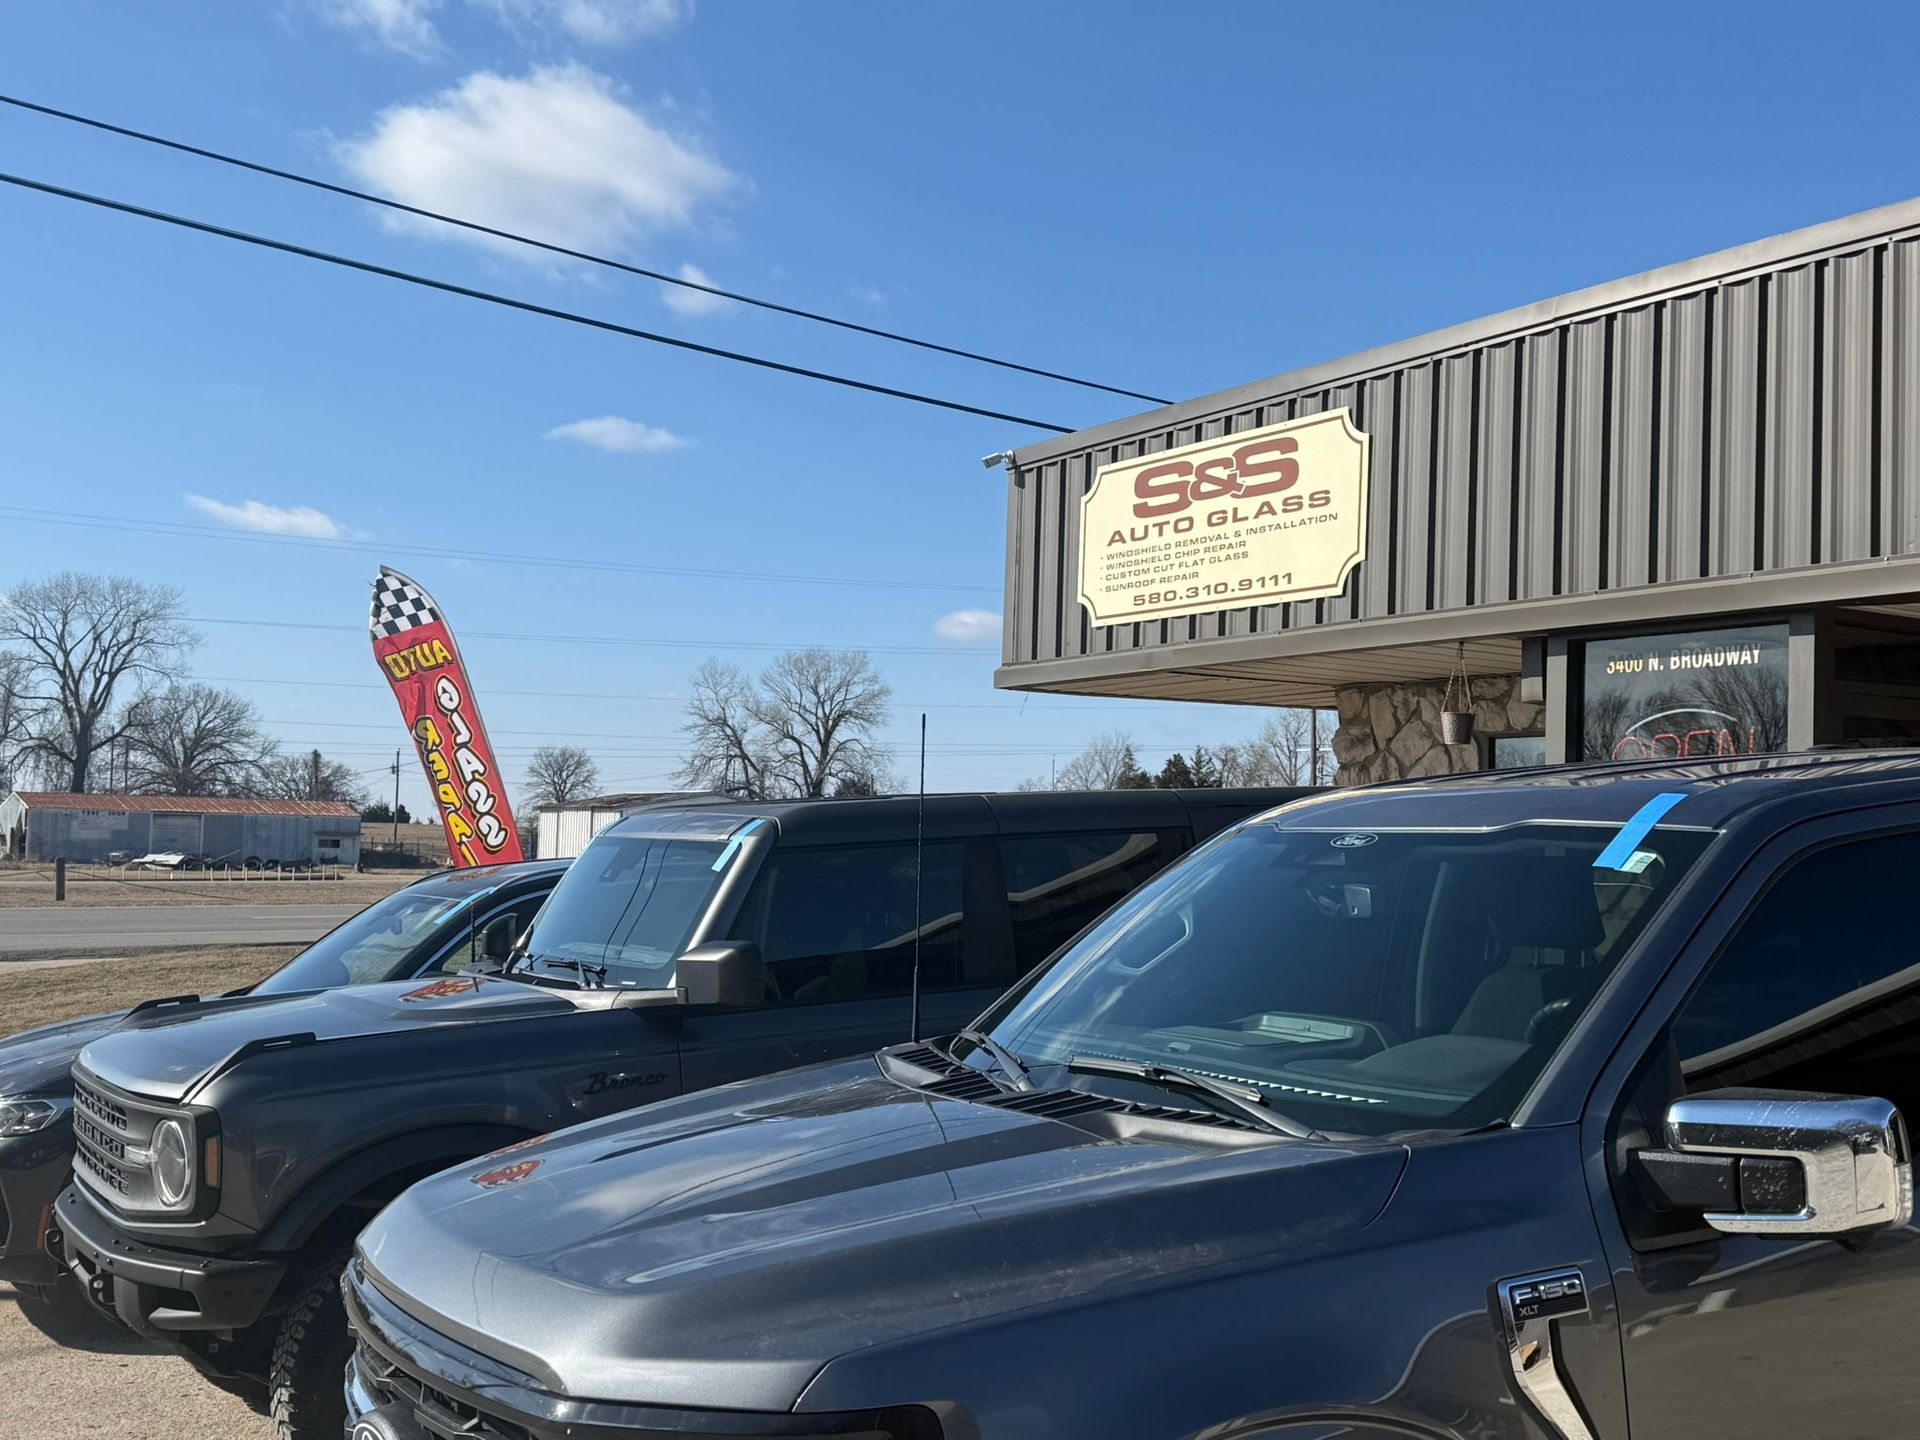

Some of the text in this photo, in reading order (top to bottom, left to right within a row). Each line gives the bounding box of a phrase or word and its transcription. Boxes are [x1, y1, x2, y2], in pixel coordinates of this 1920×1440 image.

[1133, 437, 1299, 519] S&S
[1106, 489, 1331, 547] AUTO GLASS
[1106, 513, 1338, 560] WINDSHIELD REMOVAL & INSTALLATION
[1105, 551, 1249, 581] CUSTOM CUT FLAT GLASS
[1106, 540, 1247, 570] WINDSHIELD CHIP REPAIR
[1105, 571, 1199, 593] SUNROOF REPAIR
[1133, 572, 1293, 606] 580.310.9111
[1606, 643, 1761, 674] 3400 N. BROADWAY
[1335, 834, 1372, 846] Ford
[583, 1072, 669, 1095] Bronco
[1513, 1279, 1582, 1304] F-150
[1519, 1304, 1540, 1317] XLT
